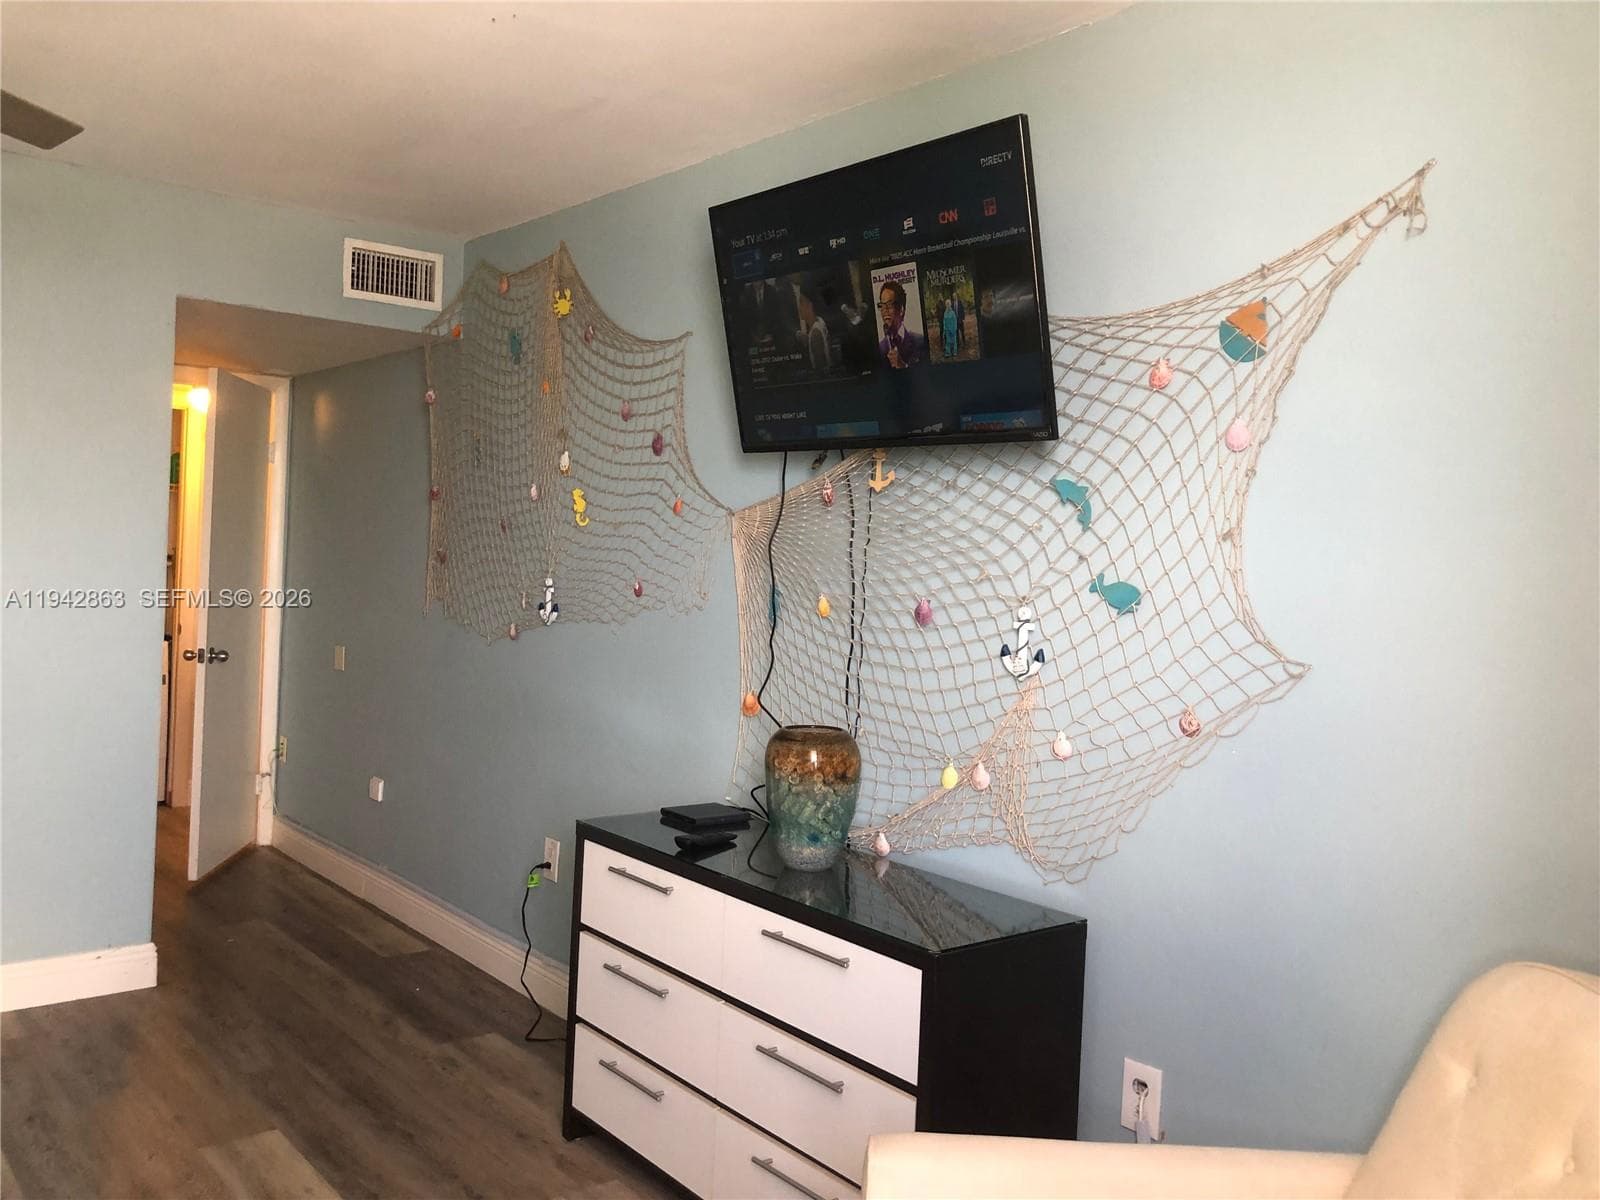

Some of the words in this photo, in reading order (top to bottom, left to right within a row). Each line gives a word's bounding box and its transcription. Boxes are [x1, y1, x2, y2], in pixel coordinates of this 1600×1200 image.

[980, 150, 1013, 167] DIRECTV
[938, 207, 959, 225] CNN
[745, 234, 755, 246] TV
[884, 268, 916, 281] HUGHLEY
